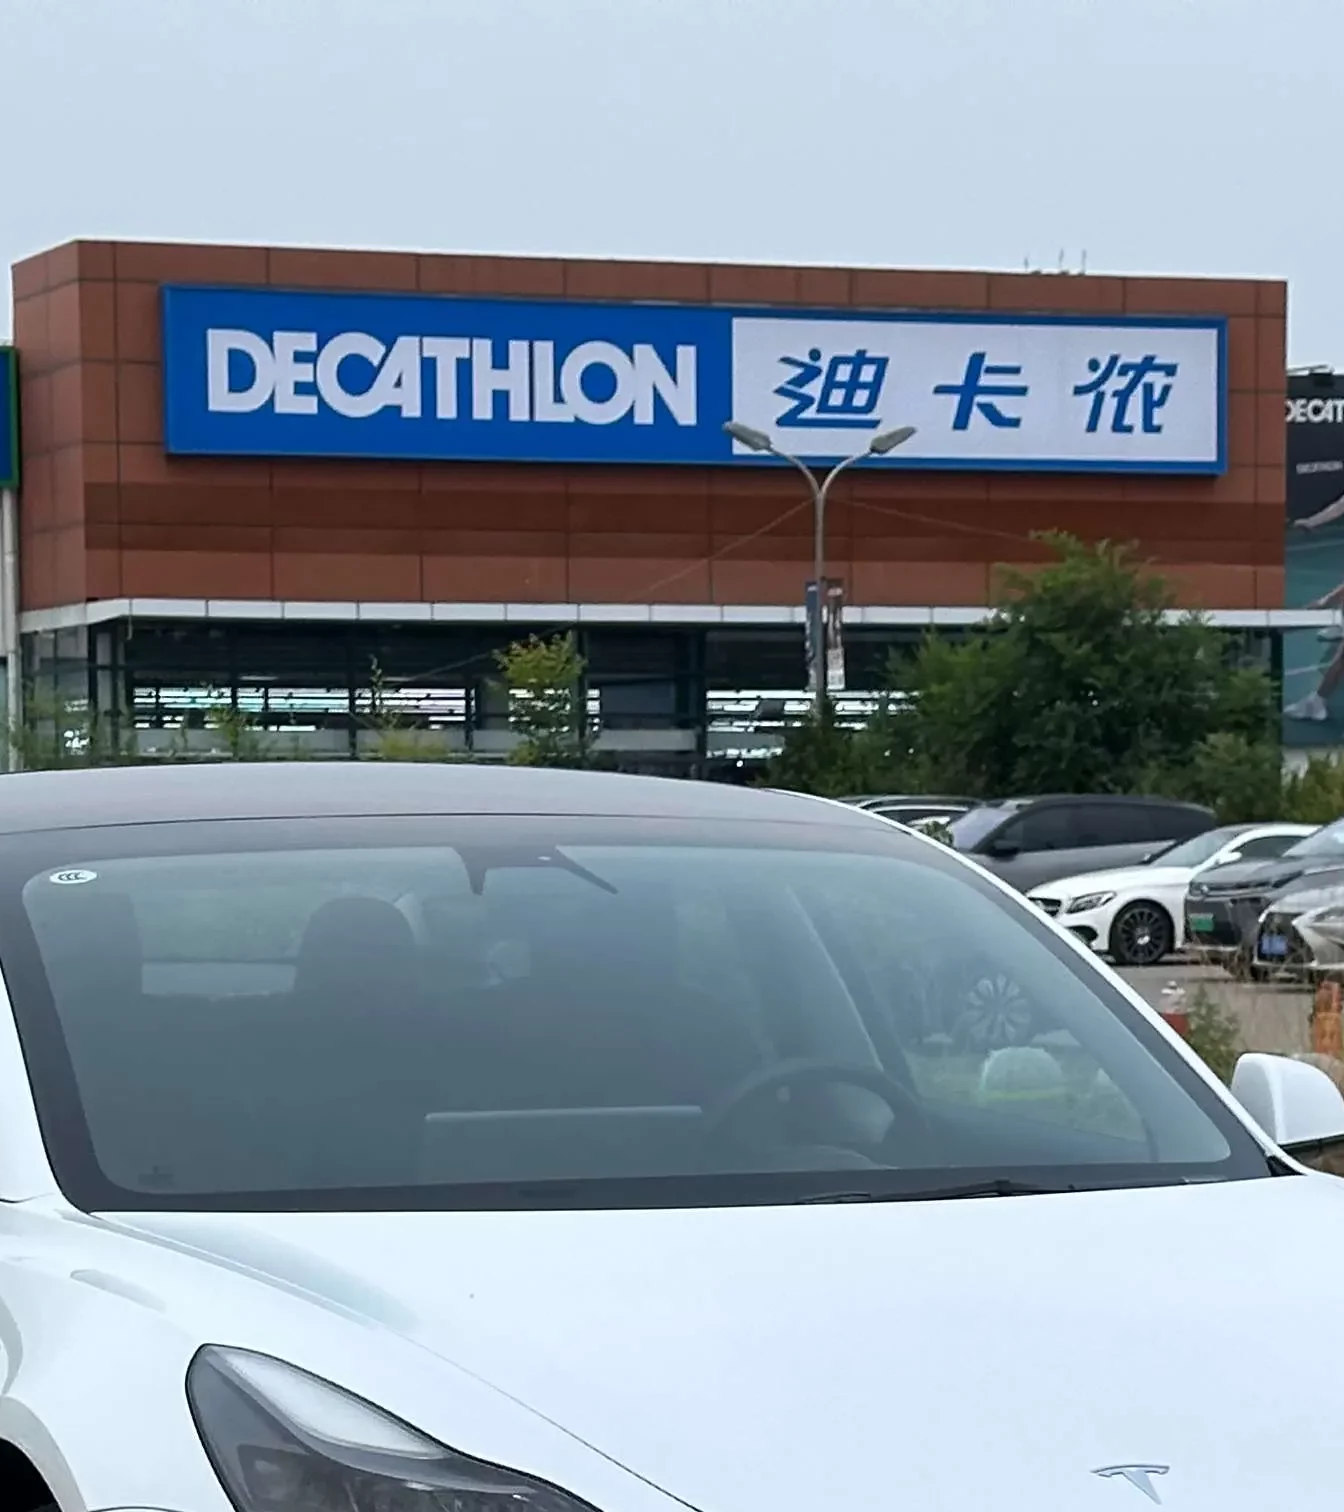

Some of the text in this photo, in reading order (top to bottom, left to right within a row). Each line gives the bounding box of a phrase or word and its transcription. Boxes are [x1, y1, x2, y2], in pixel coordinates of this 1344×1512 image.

[207, 328, 697, 426] DECATHLON
[772, 347, 1179, 435] 迪卡侬
